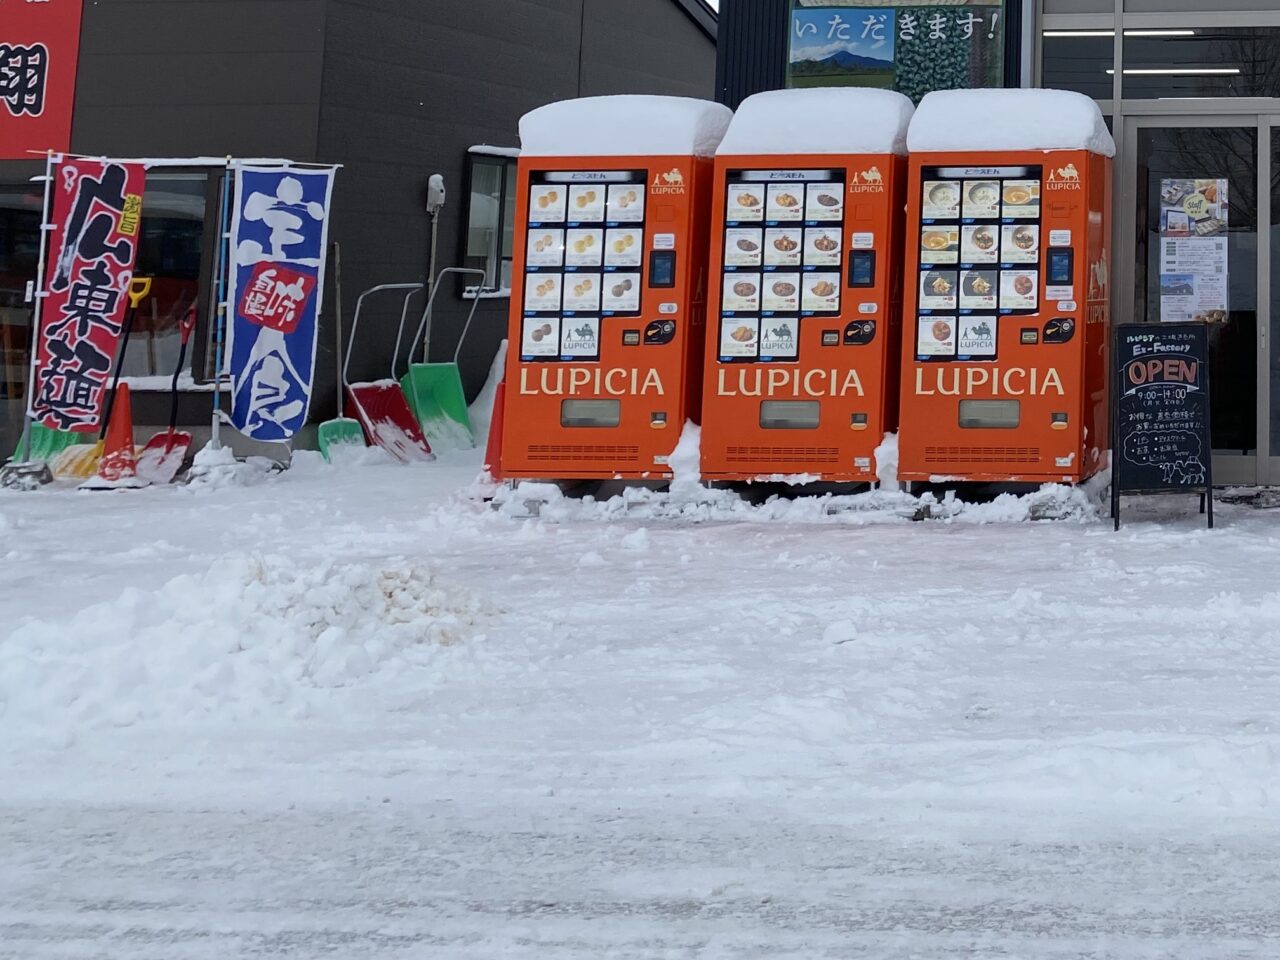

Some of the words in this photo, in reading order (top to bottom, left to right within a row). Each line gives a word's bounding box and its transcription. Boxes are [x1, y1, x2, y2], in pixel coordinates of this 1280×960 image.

[794, 12, 999, 41] いただきます!
[651, 187, 685, 195] LUPICIA
[850, 185, 884, 193] LUPICIA
[237, 176, 325, 439] 定食
[563, 342, 596, 350] LUPICIA
[761, 342, 794, 350] LUPICIA
[960, 341, 993, 349] LUPICIA
[1133, 342, 1191, 356] Ex-Factory
[519, 367, 665, 396] LUPICIA
[914, 366, 1065, 396] LUPICIA
[1128, 359, 1197, 385] OPEN
[716, 368, 865, 397] LUPICIA
